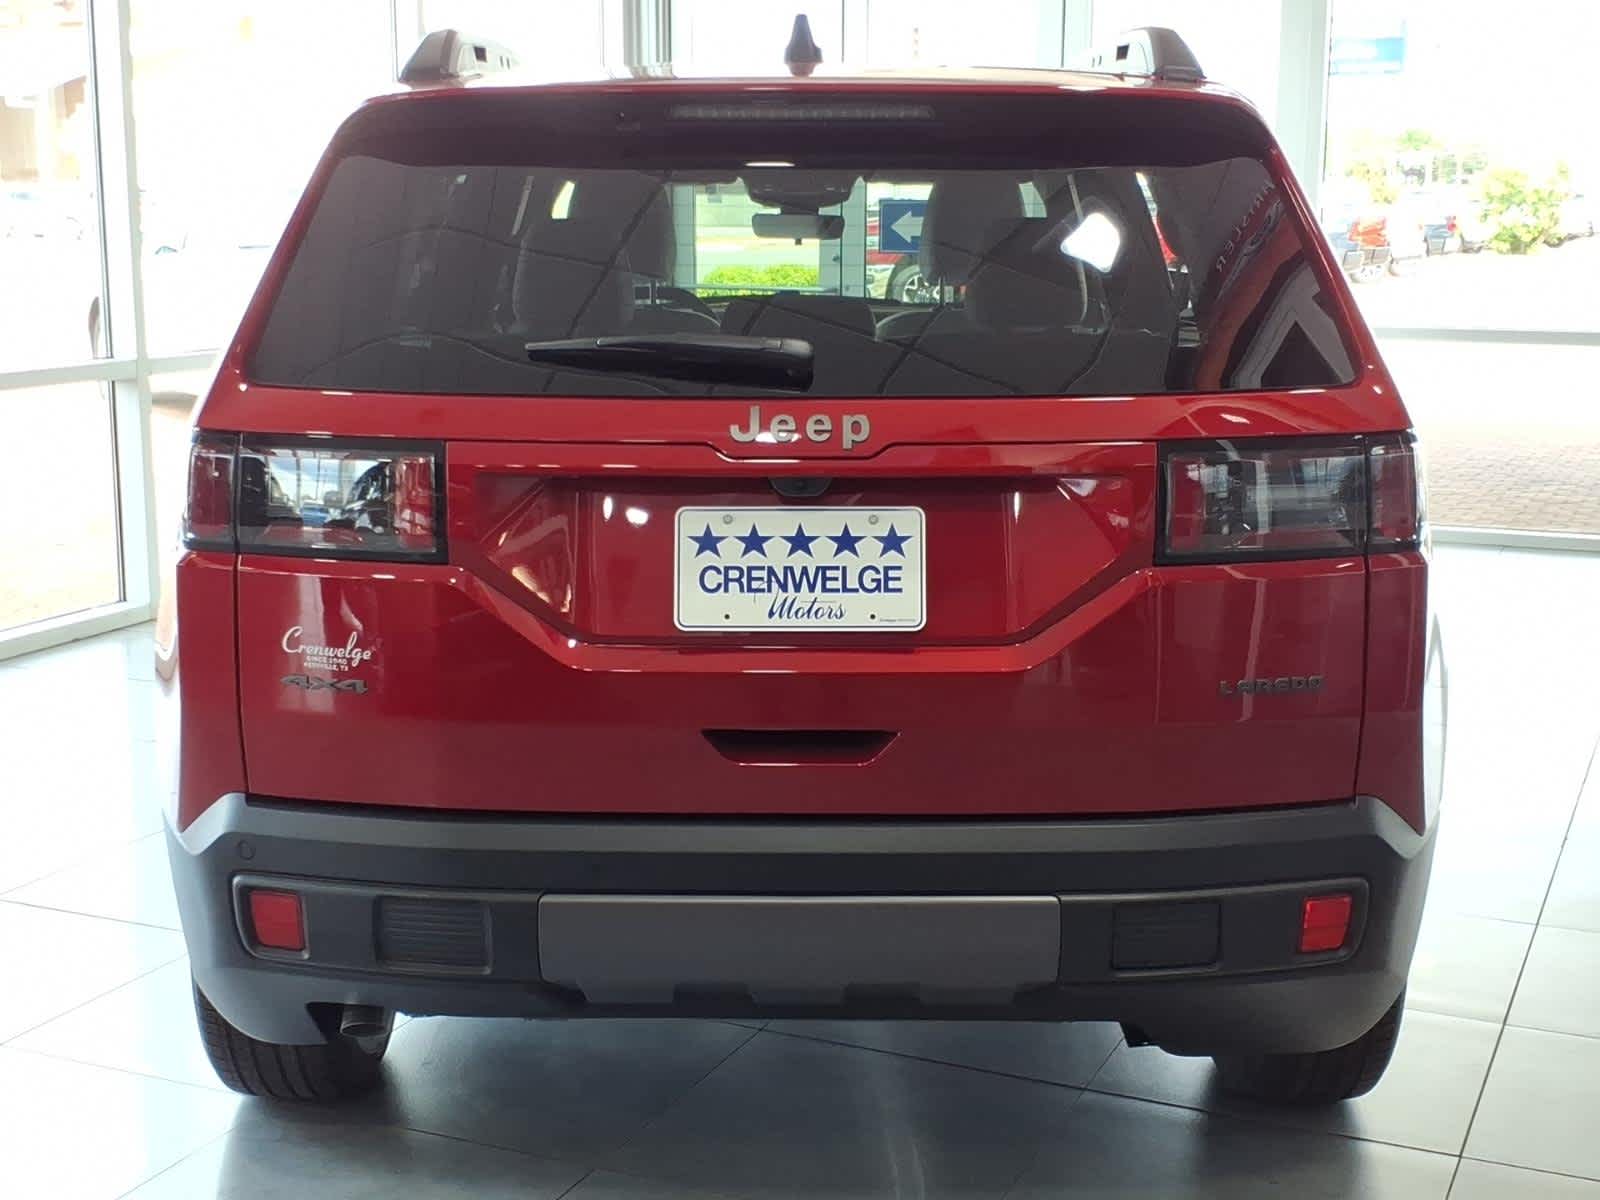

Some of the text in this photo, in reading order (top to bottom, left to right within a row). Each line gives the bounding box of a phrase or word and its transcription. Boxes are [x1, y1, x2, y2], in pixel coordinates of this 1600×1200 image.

[729, 405, 871, 450] Jeep
[699, 564, 903, 594] CRENWELGE
[767, 592, 846, 620] Motors
[282, 626, 372, 668] Crenwelge
[1219, 675, 1323, 696] LAREDO
